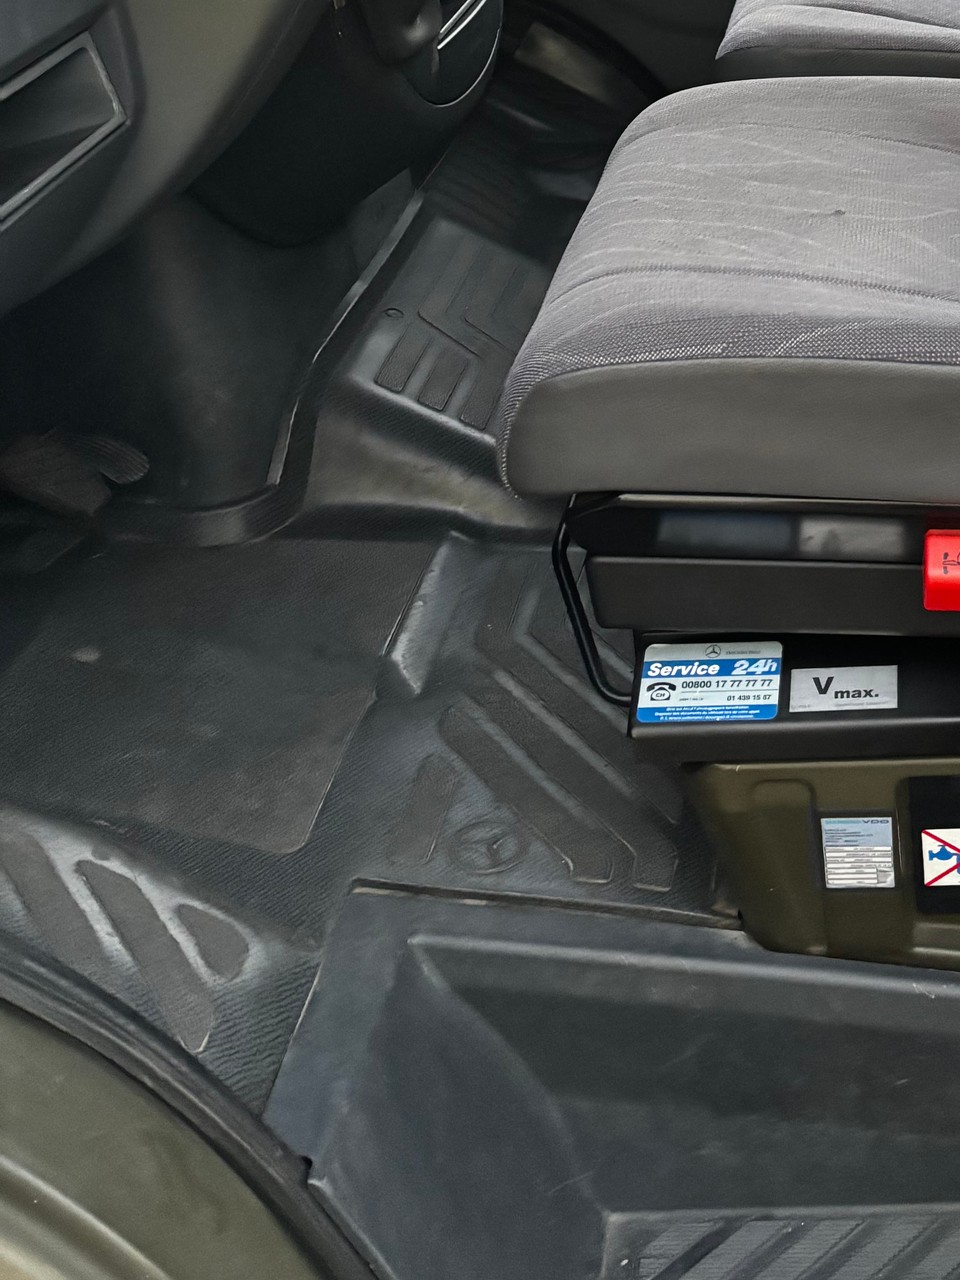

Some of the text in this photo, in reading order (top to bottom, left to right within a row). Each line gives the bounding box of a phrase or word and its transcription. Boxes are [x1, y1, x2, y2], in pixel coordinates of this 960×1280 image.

[647, 659, 778, 677] Service 24h
[681, 679, 773, 689] 00800 17 77 77 77
[834, 689, 880, 699] max.
